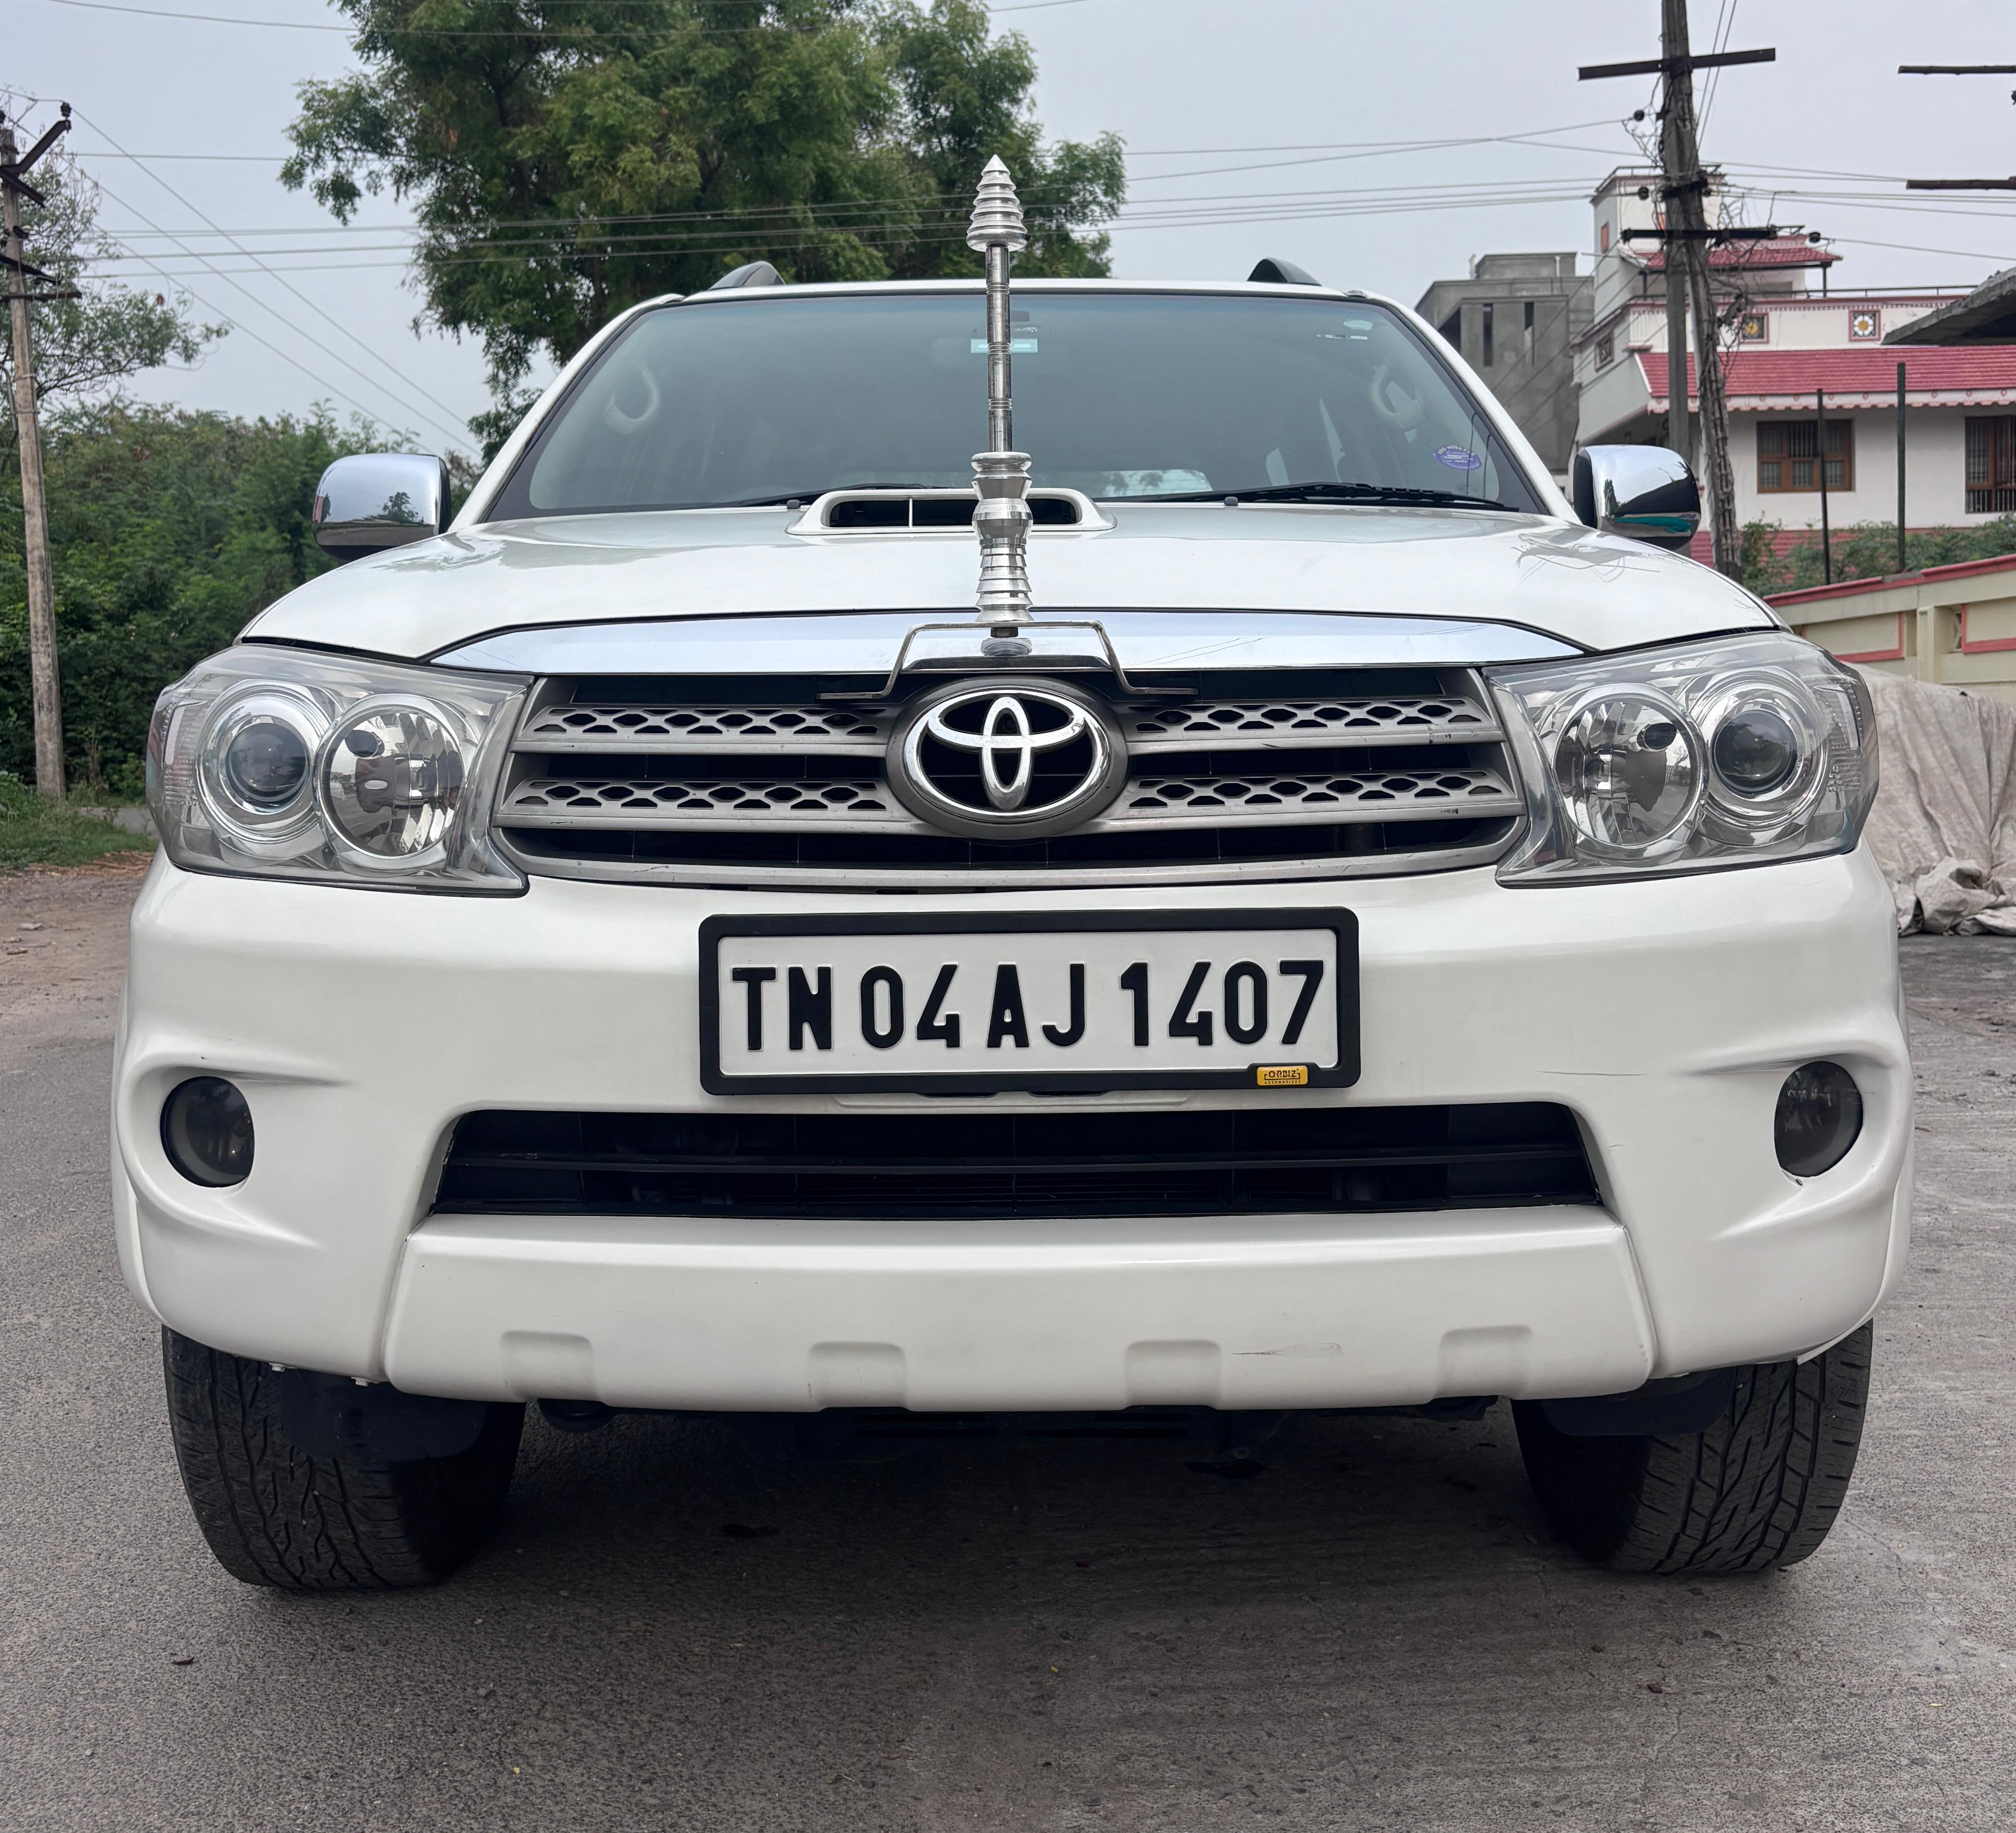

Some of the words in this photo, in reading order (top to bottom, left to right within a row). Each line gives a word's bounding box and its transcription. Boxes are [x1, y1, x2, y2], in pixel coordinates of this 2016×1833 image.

[732, 966, 832, 1050] TN
[860, 964, 960, 1049] 04
[986, 963, 1085, 1048] AJ
[1120, 960, 1324, 1046] 1407
